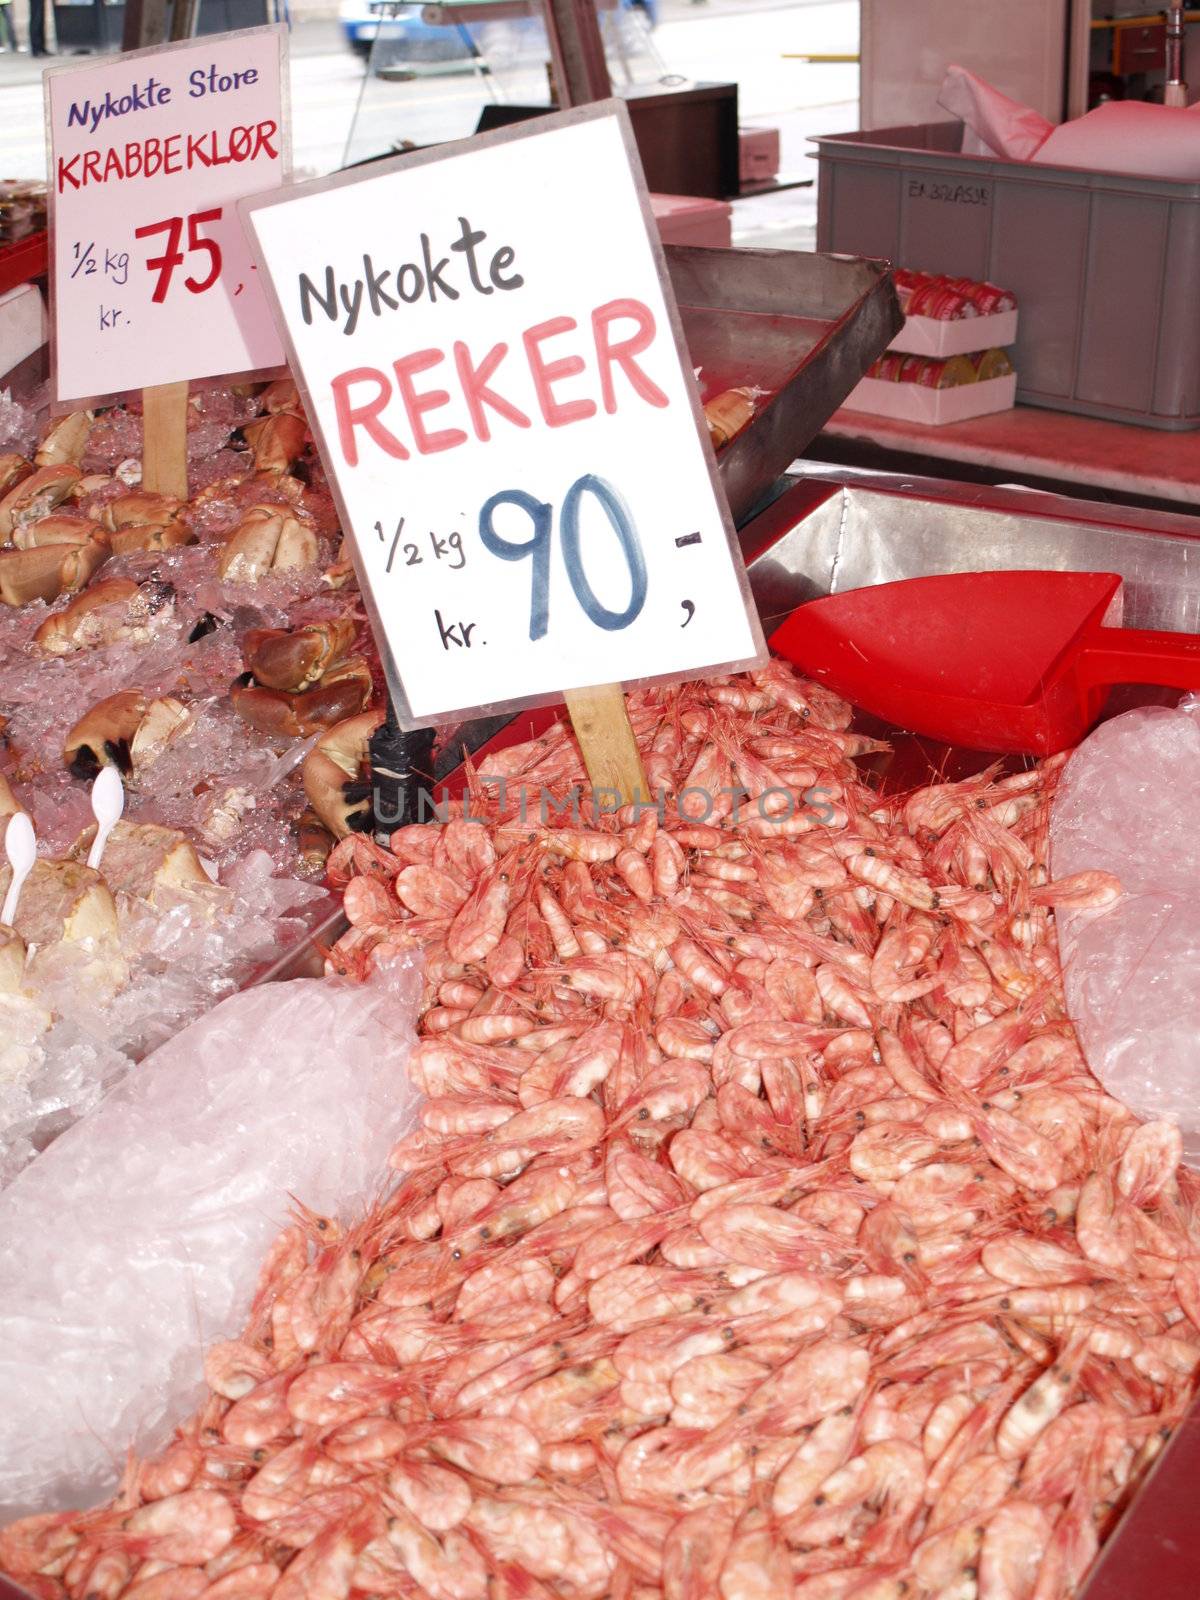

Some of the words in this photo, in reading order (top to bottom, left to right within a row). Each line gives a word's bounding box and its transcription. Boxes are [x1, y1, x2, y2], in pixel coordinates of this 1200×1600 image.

[68, 78, 171, 133] Nykokte
[189, 64, 258, 97] Store
[58, 119, 278, 193] KRABBEKLØR
[105, 249, 129, 285] kg
[299, 217, 524, 335] Nykokte
[100, 304, 131, 331] kr.
[330, 298, 670, 467] REKER
[430, 532, 466, 569] kg
[434, 610, 487, 650] kr.
